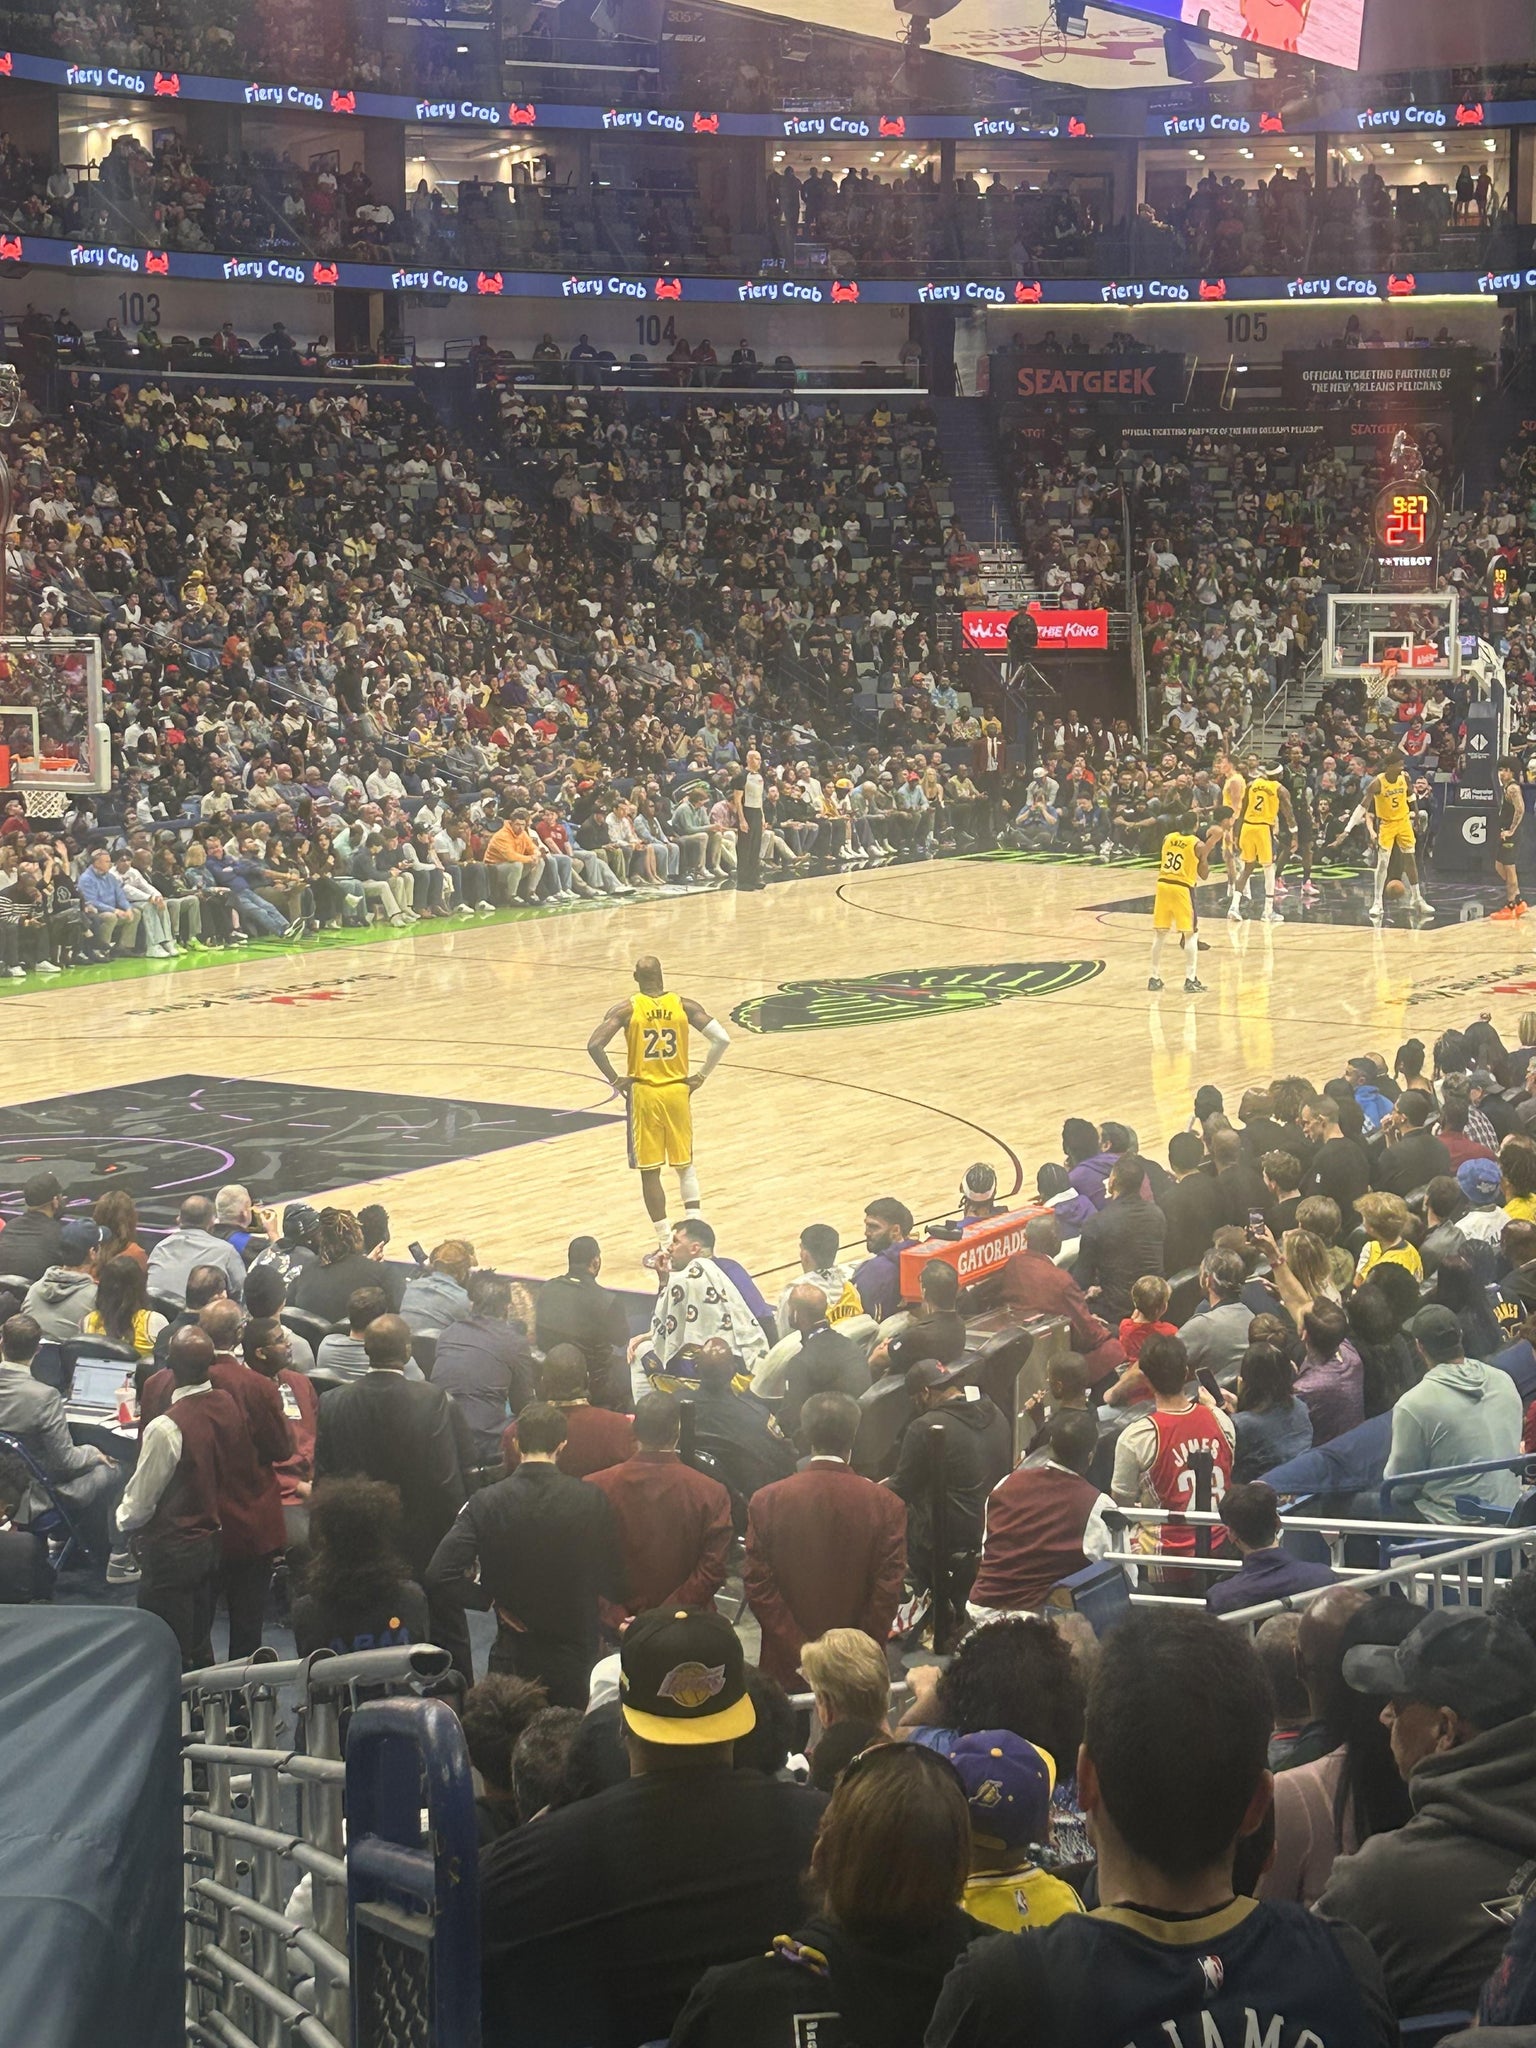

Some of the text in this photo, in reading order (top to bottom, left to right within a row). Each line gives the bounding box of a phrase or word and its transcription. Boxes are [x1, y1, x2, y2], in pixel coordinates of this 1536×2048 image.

[67, 65, 145, 93] Fiery Crab
[245, 83, 324, 110] Fiery Crab
[416, 100, 500, 124] Fiery Crab
[602, 109, 685, 132] Fiery Crab
[1357, 106, 1446, 129] Fiery Crab
[784, 116, 869, 136] Fiery Crab
[974, 117, 1015, 136] Fiery
[1163, 114, 1250, 136] Fiery Crab
[71, 245, 138, 272] Fiery Crab
[223, 258, 305, 283] Fiery Crab
[391, 269, 469, 293] Fiery Crab
[562, 277, 647, 299] Fiery Crab
[738, 281, 822, 303] Fiery Crab
[918, 282, 1006, 303] Fiery Crab
[1101, 281, 1189, 301] Fiery Crab
[1287, 276, 1377, 297] Fiery Crab
[1478, 272, 1520, 293] Fiery
[119, 292, 161, 327] 103
[635, 315, 677, 346] 104
[1224, 312, 1268, 343] 105
[1017, 367, 1156, 396] SEATGEEK
[1302, 368, 1451, 381] OFFICIAL TICKETING PARTNER OF
[1311, 381, 1443, 393] THE NEW ORLEANS PELICANS
[1393, 496, 1428, 514] 9:27
[1385, 513, 1424, 545] 24
[995, 623, 1062, 638] STHIE
[1254, 795, 1264, 812] 2
[1391, 797, 1399, 808] 5
[1163, 851, 1184, 871] 36
[643, 1028, 677, 1059] 23
[957, 1229, 1028, 1275] GATORADE
[1172, 1438, 1220, 1468] JAMES
